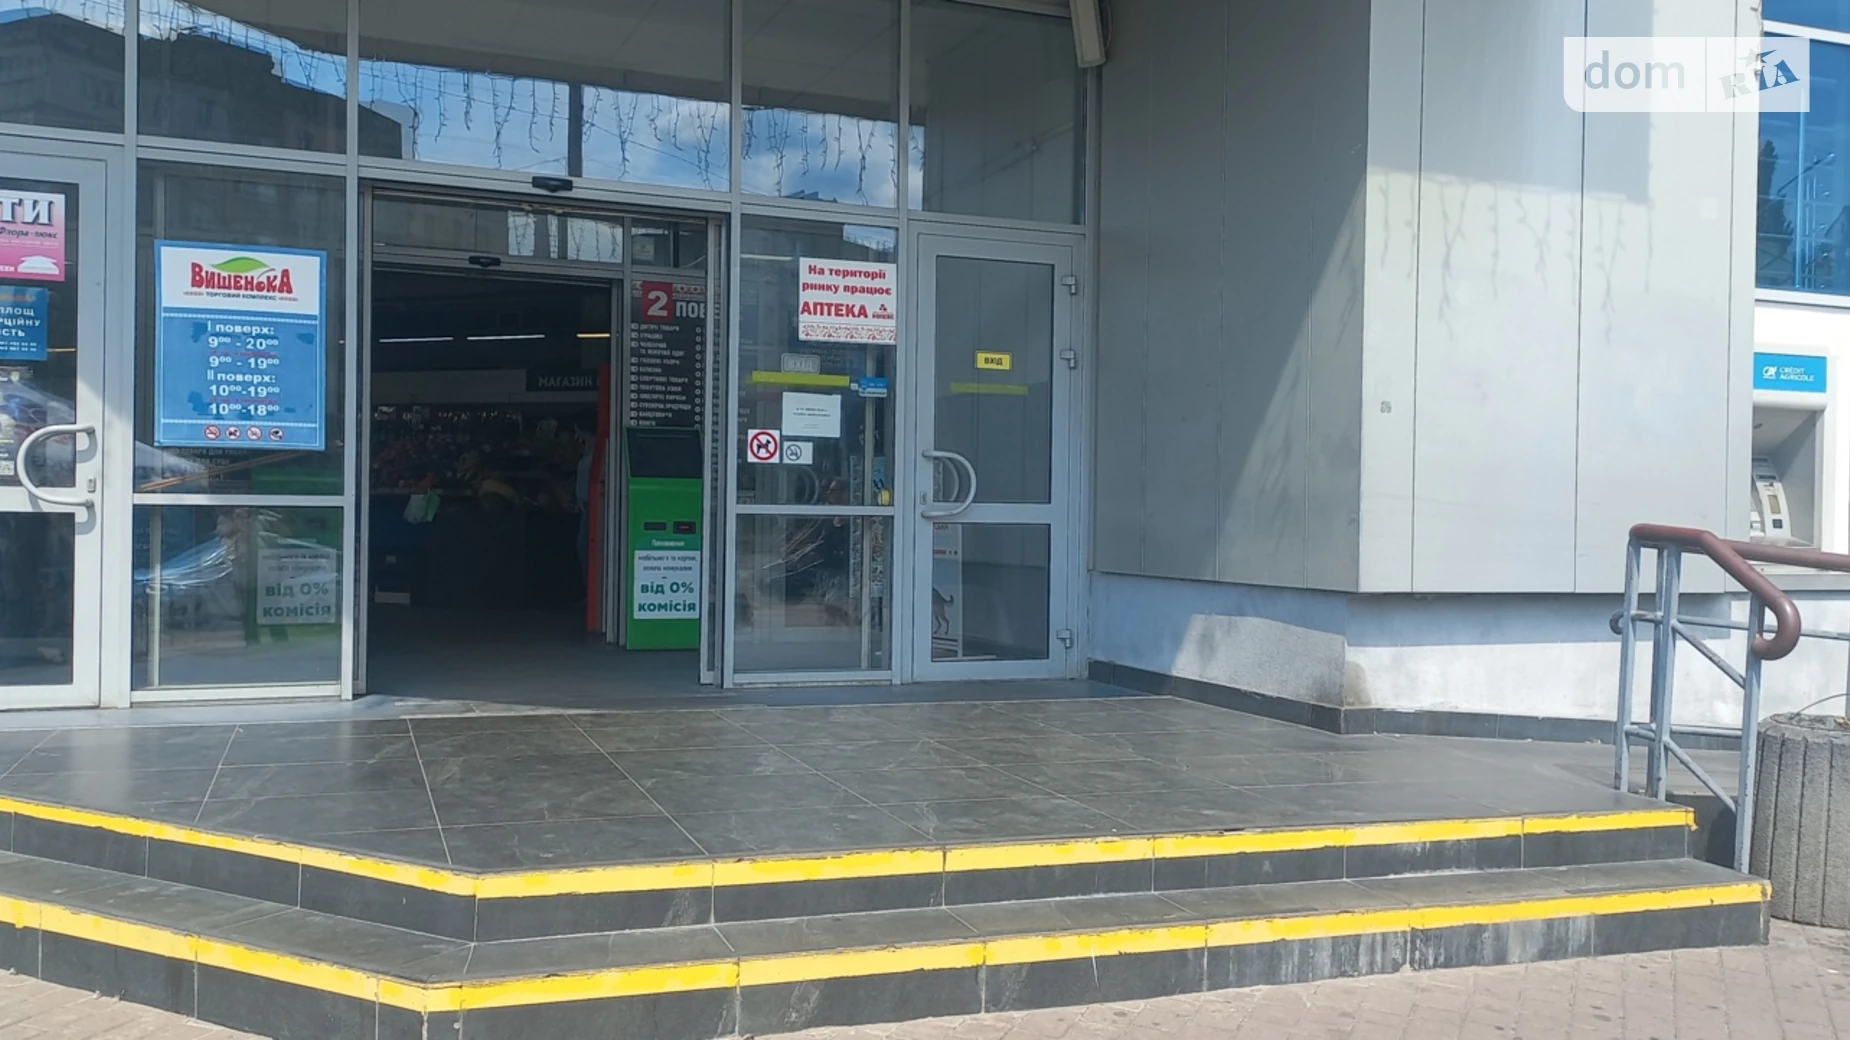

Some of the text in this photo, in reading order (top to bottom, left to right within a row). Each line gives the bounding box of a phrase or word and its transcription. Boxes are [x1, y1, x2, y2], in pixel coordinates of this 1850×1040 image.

[808, 264, 887, 281] На території
[802, 282, 892, 296] ринку працює
[206, 291, 277, 301] ТОРГОВИЙ КОМПЛЕКС
[647, 290, 668, 316] 2
[801, 301, 868, 319] АПТЕКА
[215, 322, 274, 335] поверх:
[983, 357, 1003, 366] ВХІД
[217, 372, 276, 384] поверх:
[538, 376, 592, 388] МАГАЗИН
[1779, 374, 1814, 382] AGRICOLE
[265, 582, 328, 597] від 0%
[641, 581, 694, 595] від 0%
[263, 603, 331, 618] комісія
[638, 600, 696, 613] комісія
